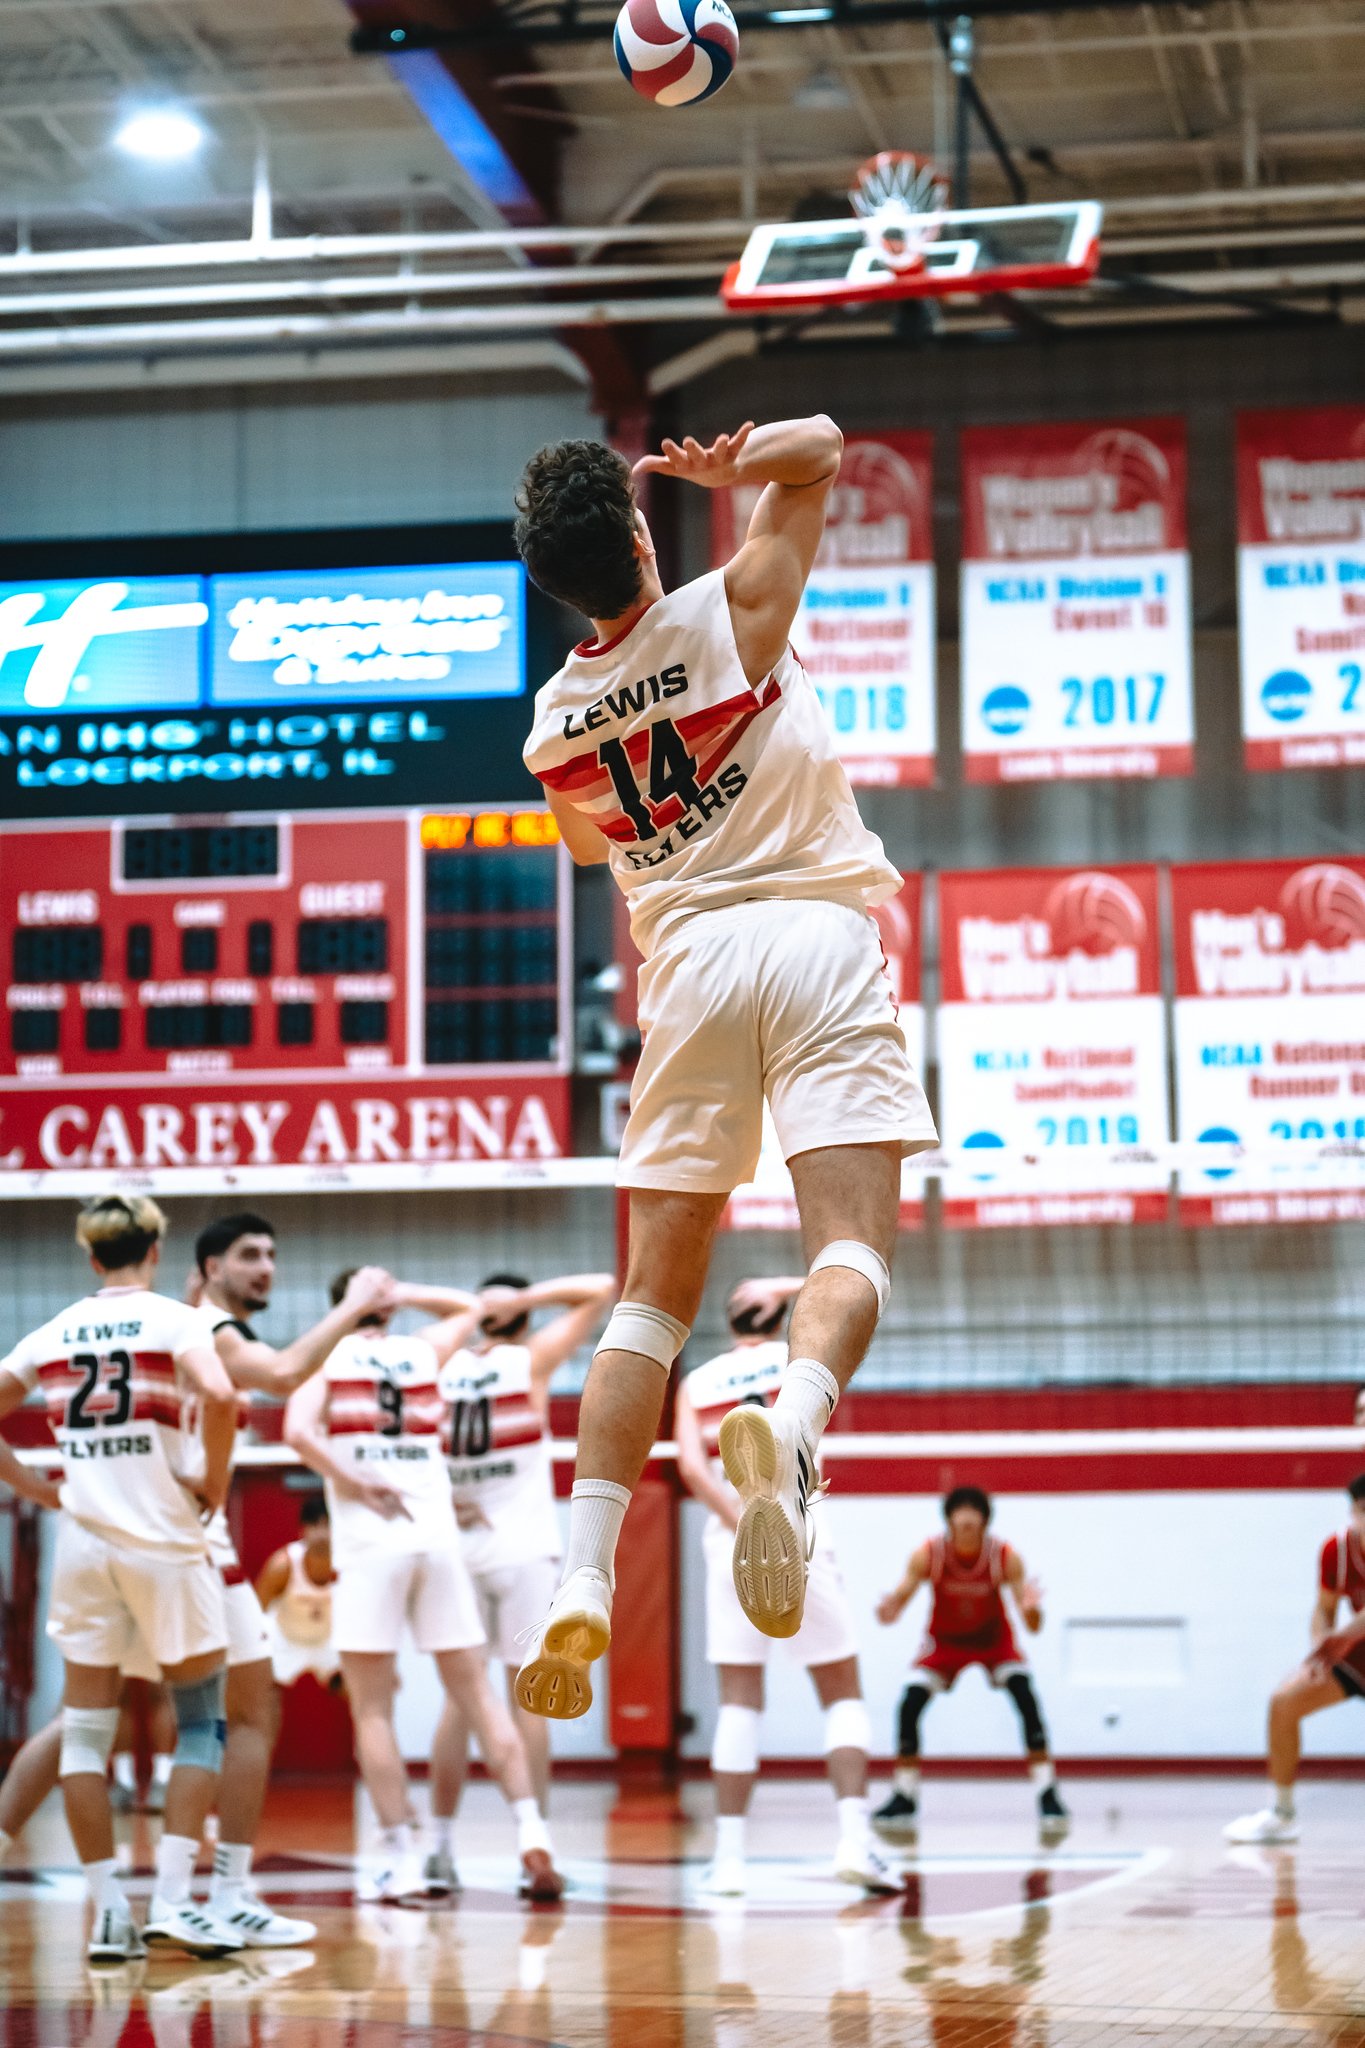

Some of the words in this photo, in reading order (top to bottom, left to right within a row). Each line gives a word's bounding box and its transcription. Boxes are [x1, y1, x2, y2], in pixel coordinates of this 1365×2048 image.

[229, 711, 446, 747] HOTEL
[563, 664, 688, 740] LEWIS
[815, 683, 906, 733] 018
[1060, 671, 1167, 728] 2017
[600, 718, 705, 841] 14
[39, 1101, 291, 1169] CAREY
[299, 1095, 562, 1164] ARENA
[63, 1320, 142, 1344] LEWIS
[68, 1350, 131, 1430] 23
[379, 1379, 403, 1436] 9
[452, 1396, 491, 1457] 10
